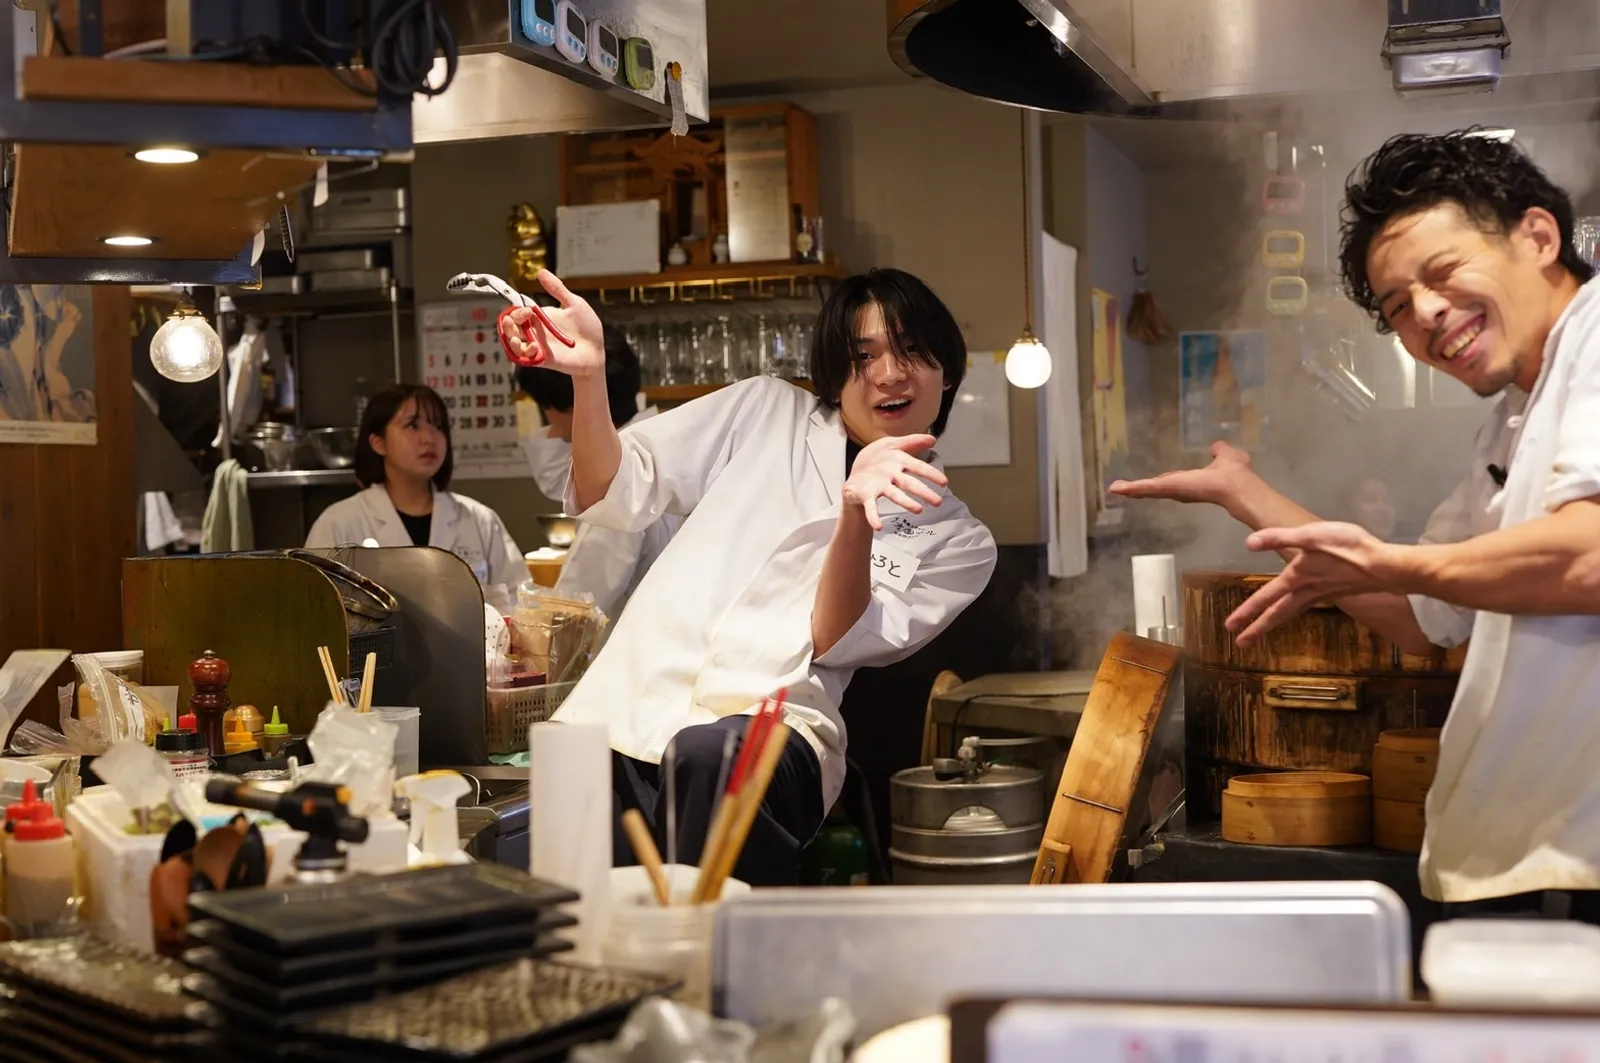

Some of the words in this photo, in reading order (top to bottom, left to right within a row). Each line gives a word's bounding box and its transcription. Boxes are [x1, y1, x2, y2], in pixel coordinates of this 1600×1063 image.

[428, 354, 435, 368] 5
[444, 354, 452, 367] 6
[461, 352, 468, 366] 7
[493, 351, 501, 364] 9
[426, 376, 440, 389] 12
[443, 374, 455, 388] 13
[459, 373, 471, 387] 14
[491, 372, 504, 385] 16
[460, 394, 472, 408] 21
[492, 393, 505, 407] 23
[460, 416, 472, 430] 28
[492, 414, 505, 428] 30
